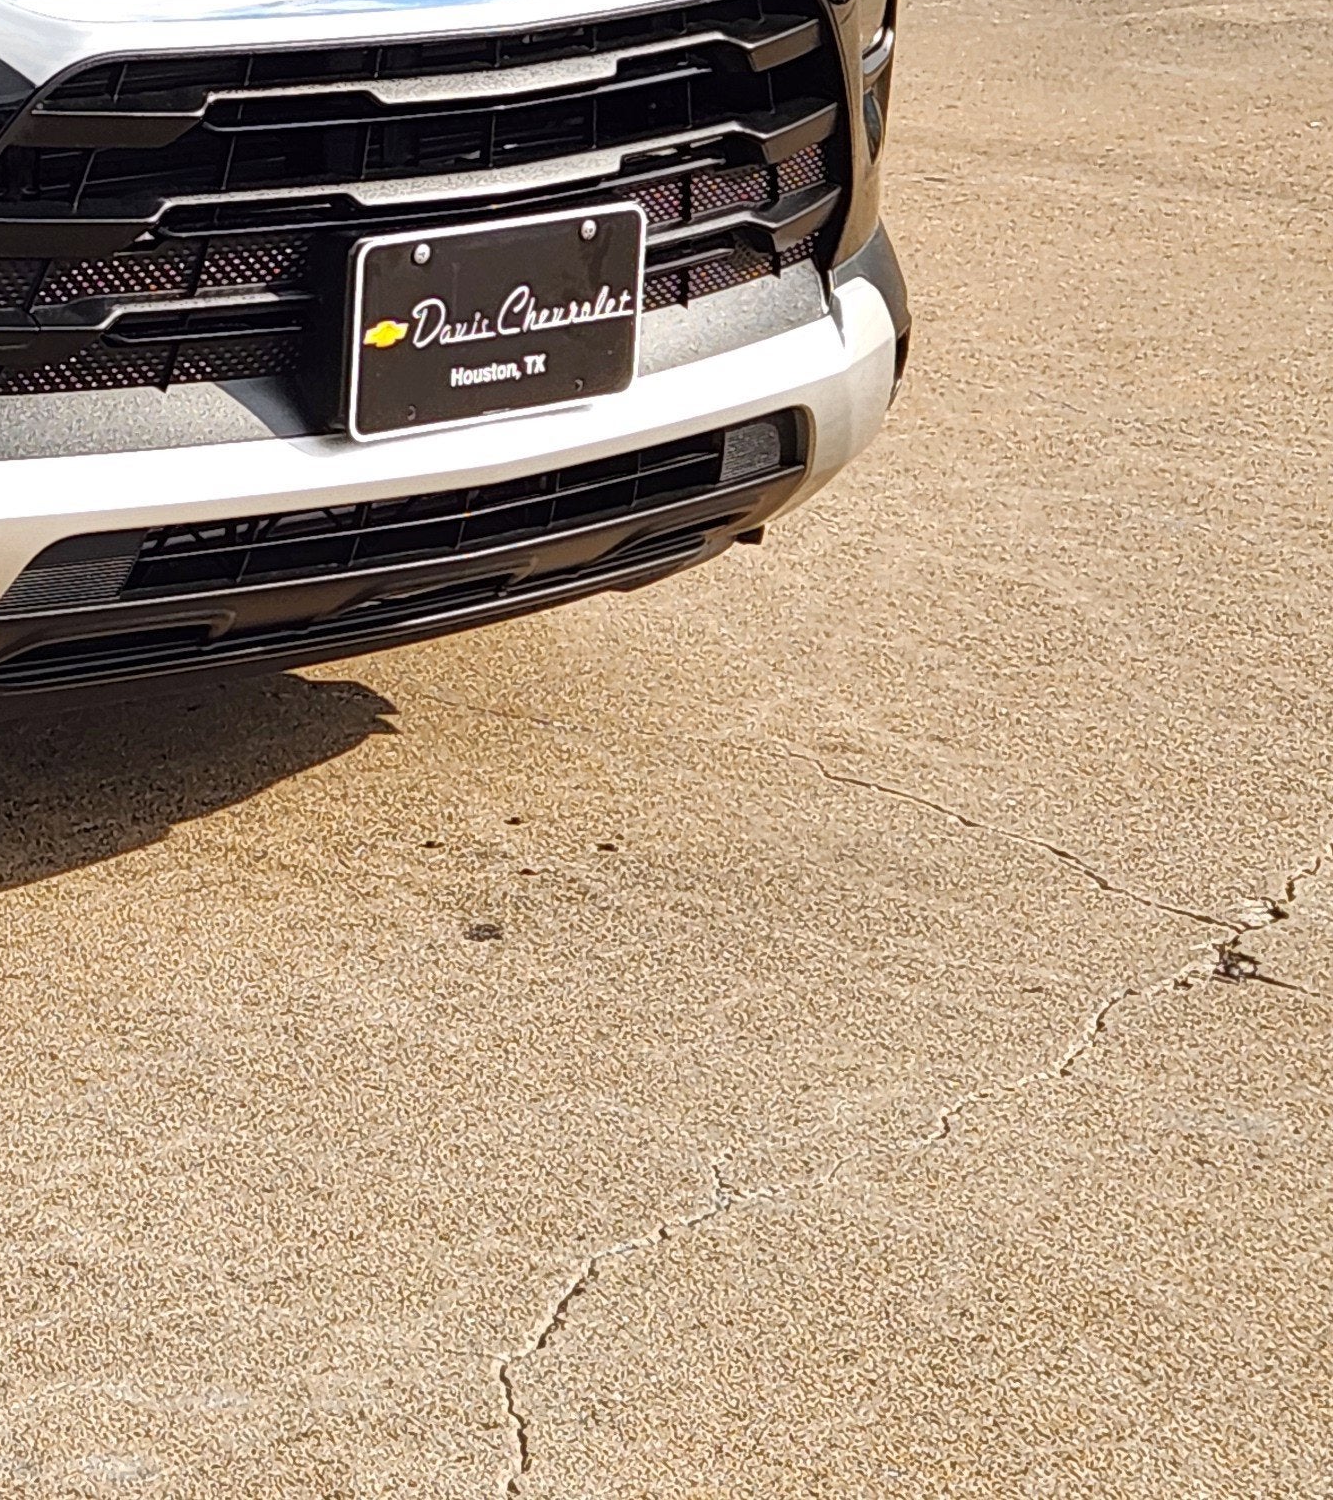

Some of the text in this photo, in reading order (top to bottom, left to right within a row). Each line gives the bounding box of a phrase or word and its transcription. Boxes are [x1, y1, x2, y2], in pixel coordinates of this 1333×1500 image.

[412, 285, 635, 349] Davis Chevrolet
[450, 353, 547, 387] Houston, TX
